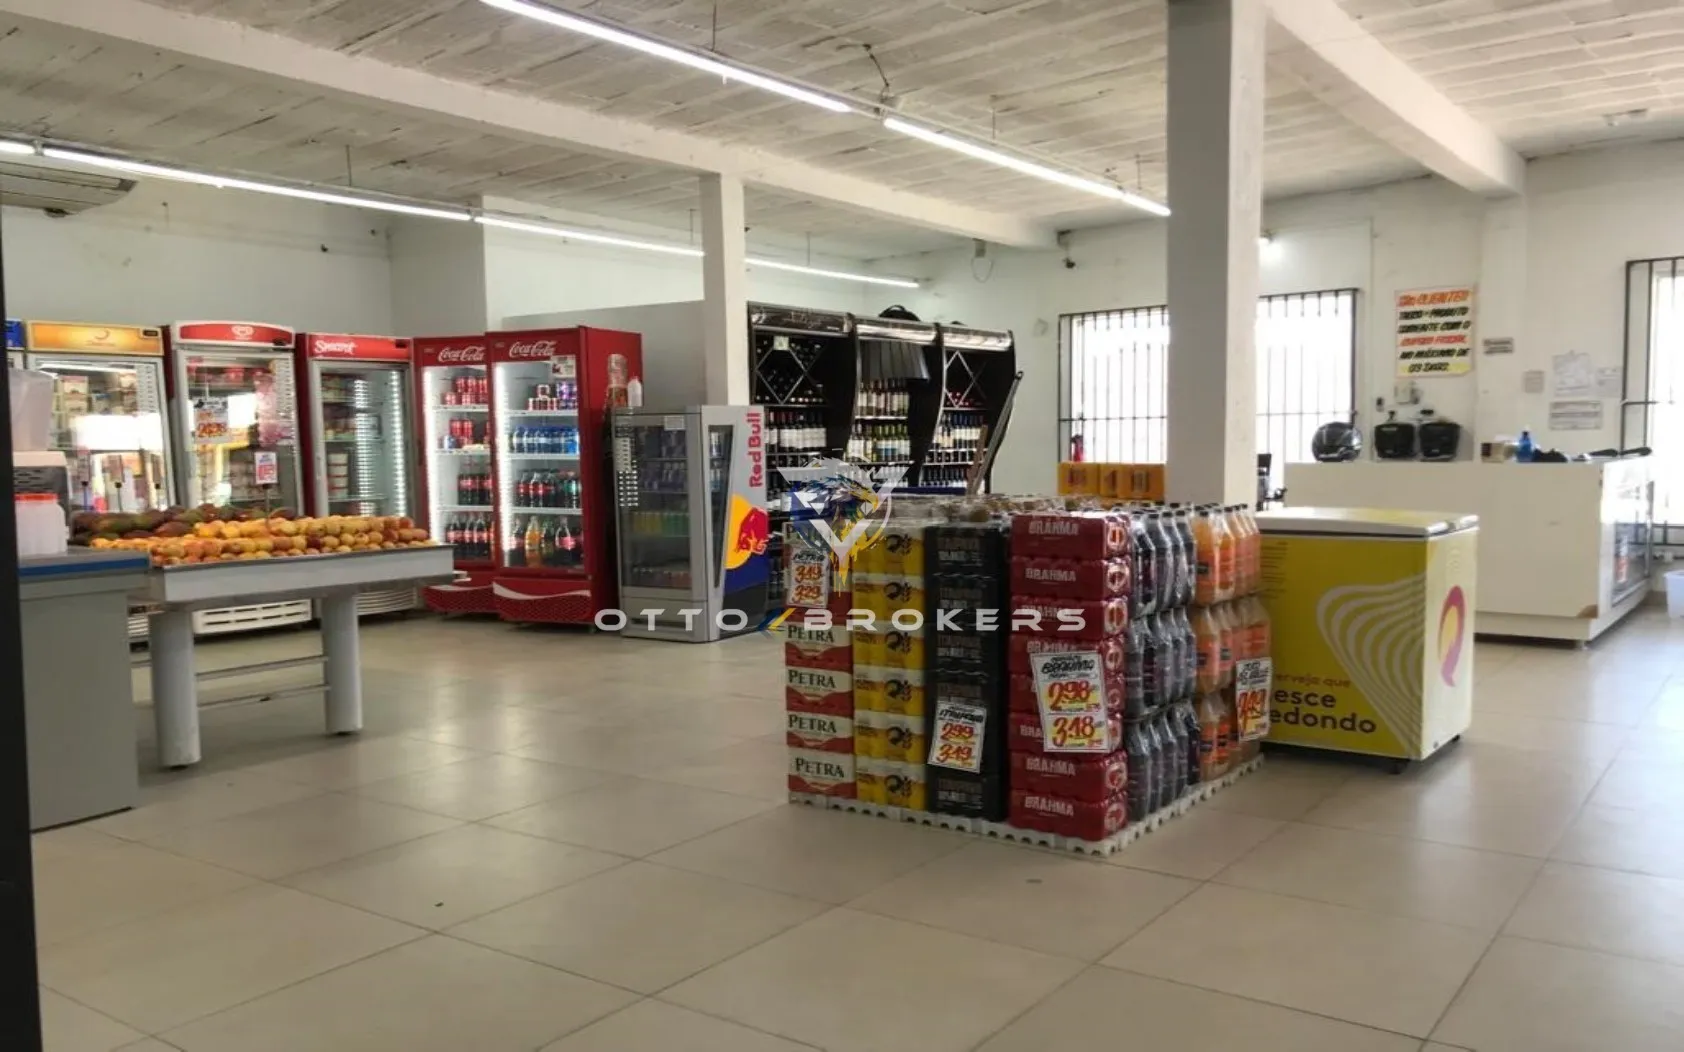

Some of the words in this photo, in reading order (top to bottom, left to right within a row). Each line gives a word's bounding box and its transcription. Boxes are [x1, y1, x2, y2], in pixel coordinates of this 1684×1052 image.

[746, 412, 762, 448] Bull
[748, 451, 763, 487] Red
[1028, 519, 1079, 536] BRAHMA
[1025, 567, 1077, 582] BRAHMA
[787, 624, 835, 643] PETRA
[788, 669, 836, 689] PETRA
[1275, 673, 1321, 686] erveja
[1274, 689, 1337, 708] esce
[788, 714, 837, 734] PETRA
[1269, 706, 1377, 734] edondo
[795, 757, 845, 778] PETRA
[1026, 756, 1077, 776] BRAHMA
[1024, 795, 1075, 817] BRAHMA
